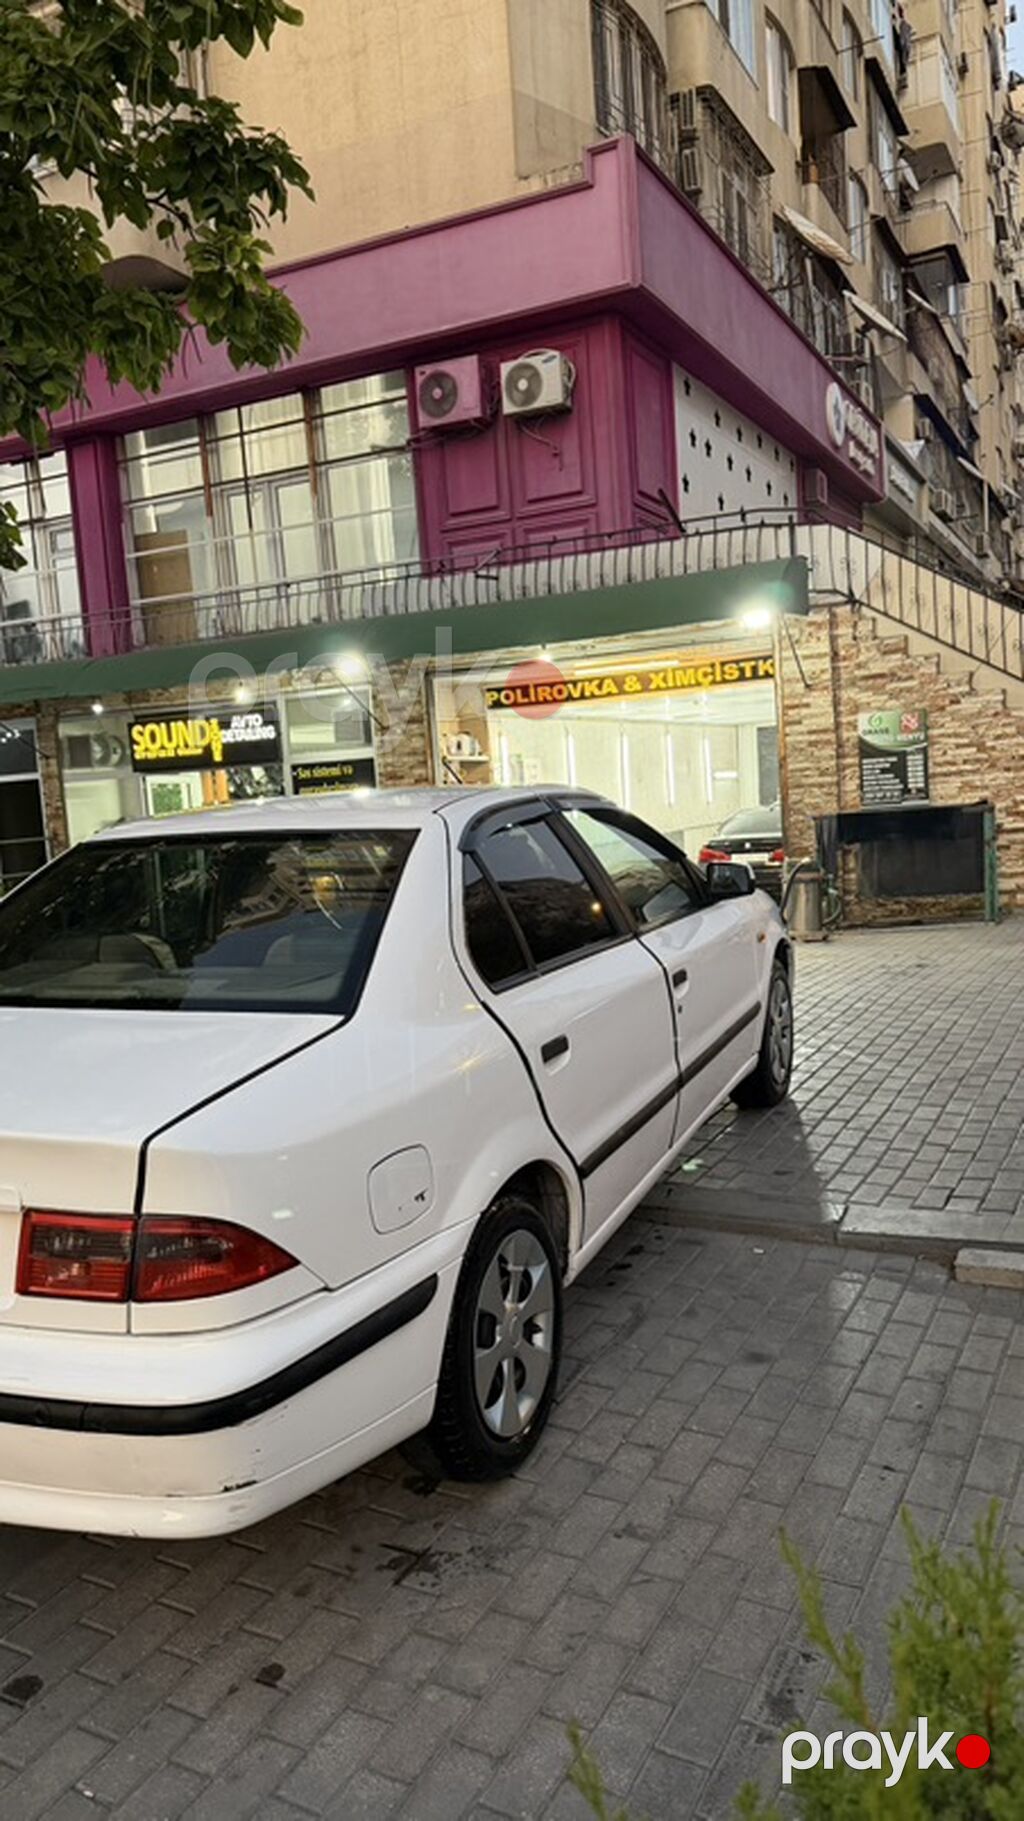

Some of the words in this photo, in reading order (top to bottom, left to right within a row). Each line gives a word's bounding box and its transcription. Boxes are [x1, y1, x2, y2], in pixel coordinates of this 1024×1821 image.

[485, 677, 619, 706] POLİROVKA
[623, 674, 642, 692] &
[131, 720, 210, 751] SOUND
